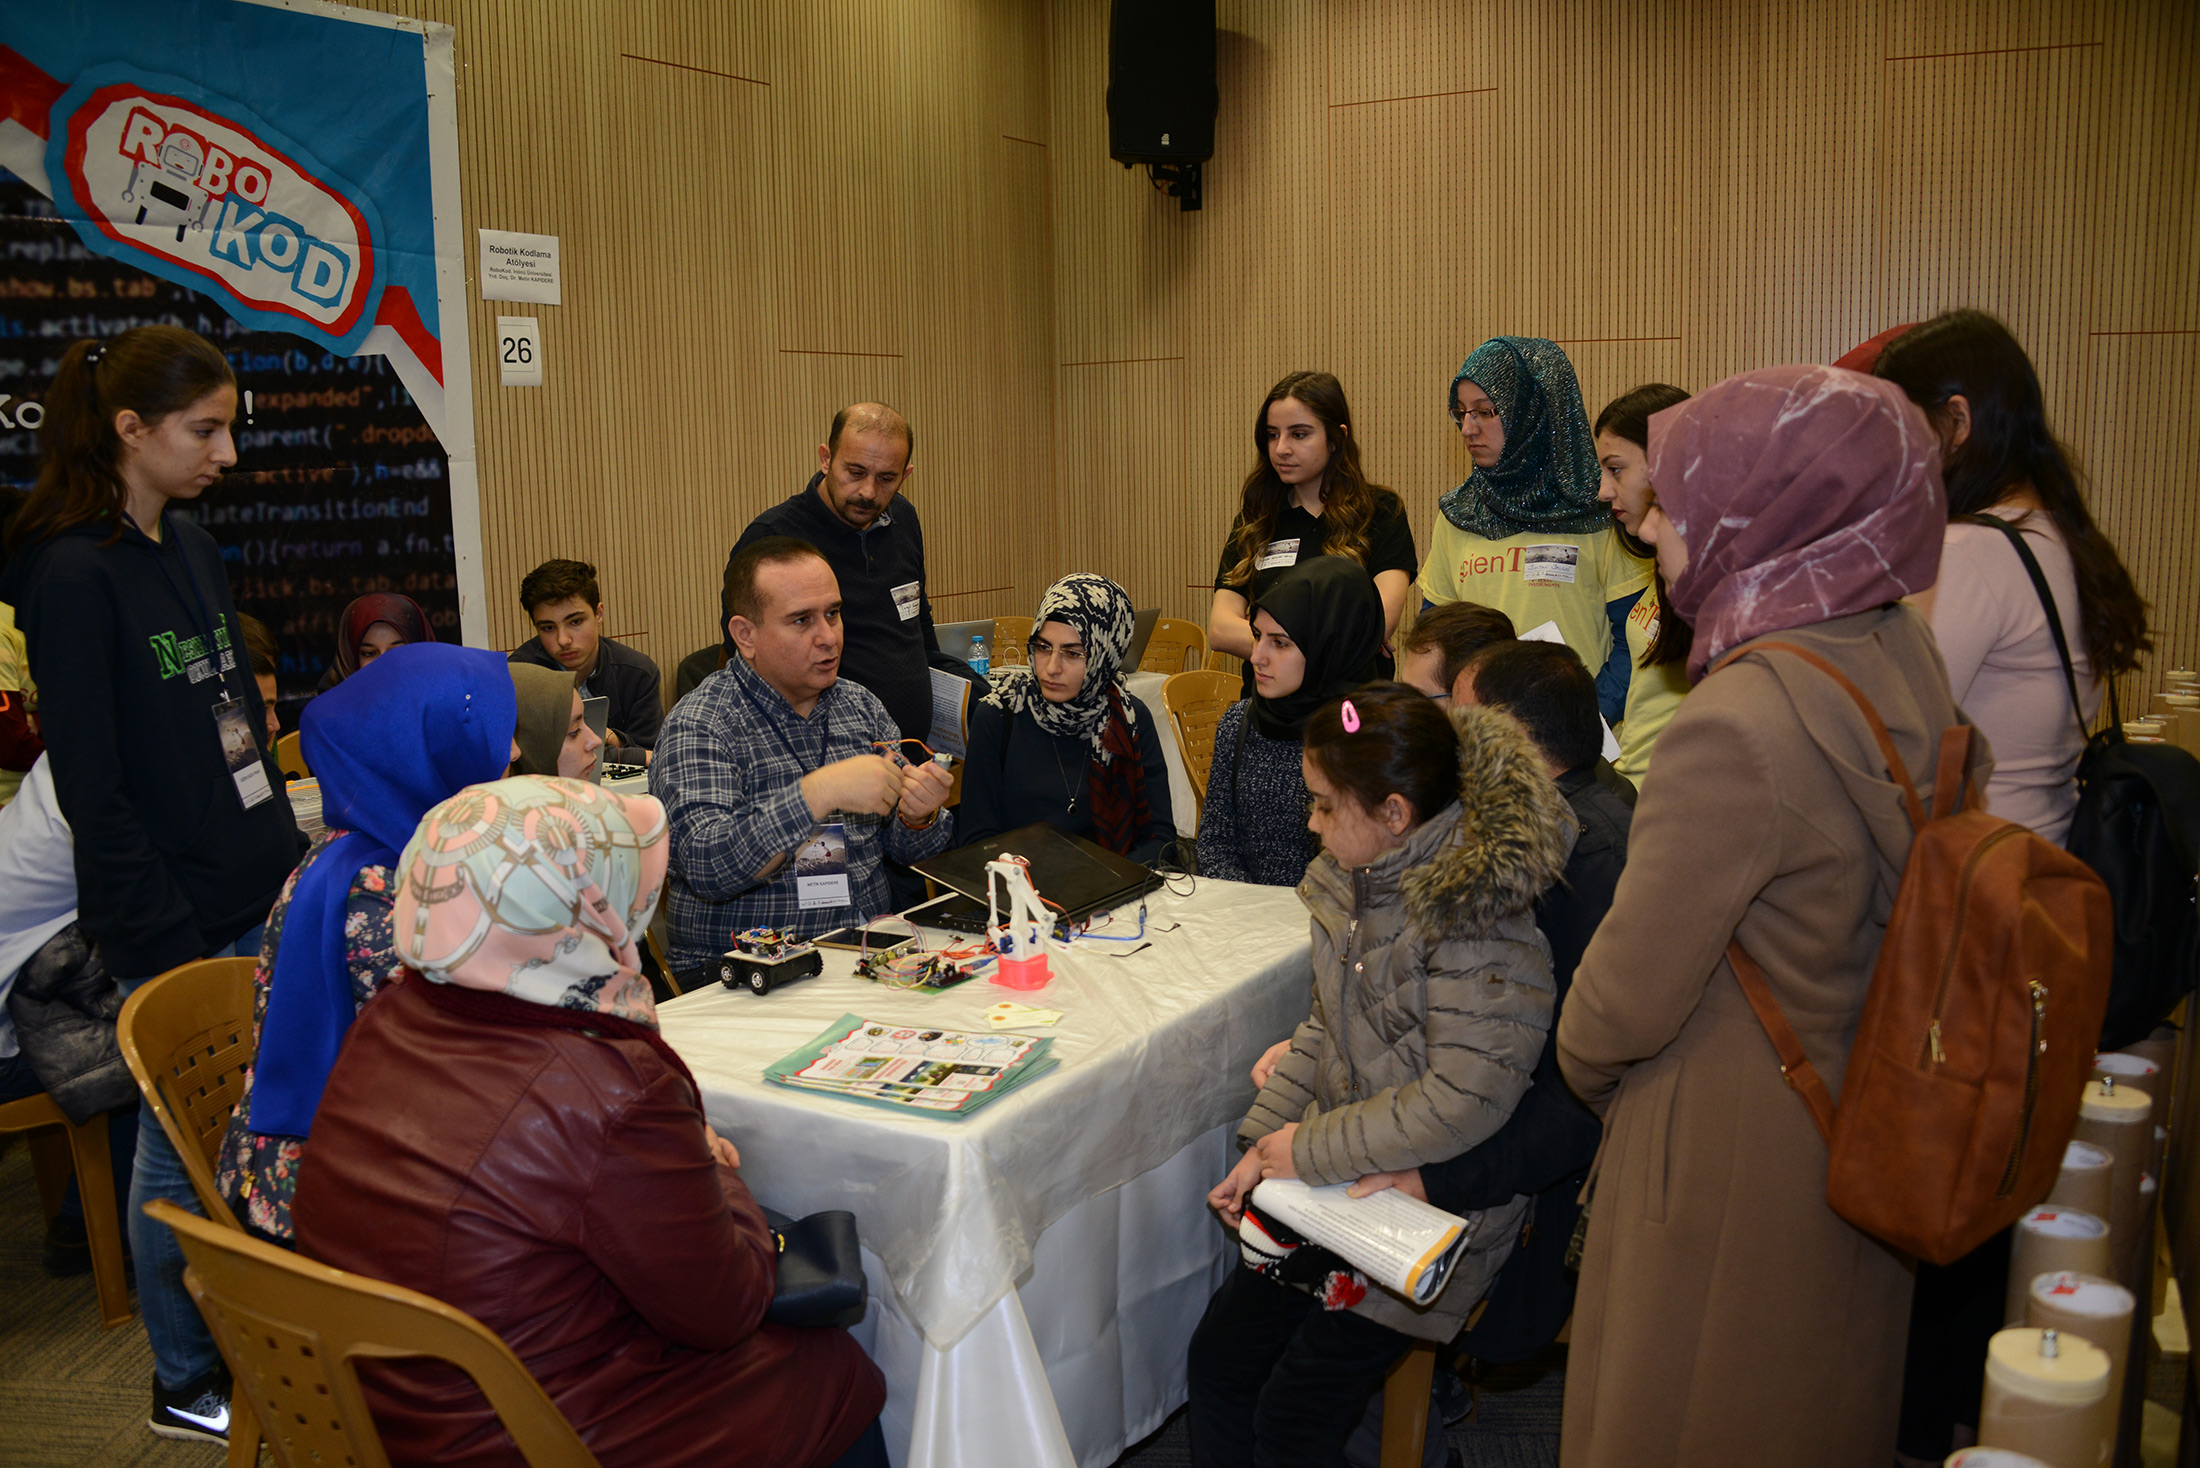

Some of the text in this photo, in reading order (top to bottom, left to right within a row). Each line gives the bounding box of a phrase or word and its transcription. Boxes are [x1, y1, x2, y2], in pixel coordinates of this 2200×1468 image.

[211, 194, 350, 306] KOD
[489, 245, 552, 259] Robotik Kodlama
[505, 257, 536, 268] Atölyesi
[503, 337, 532, 364] 26
